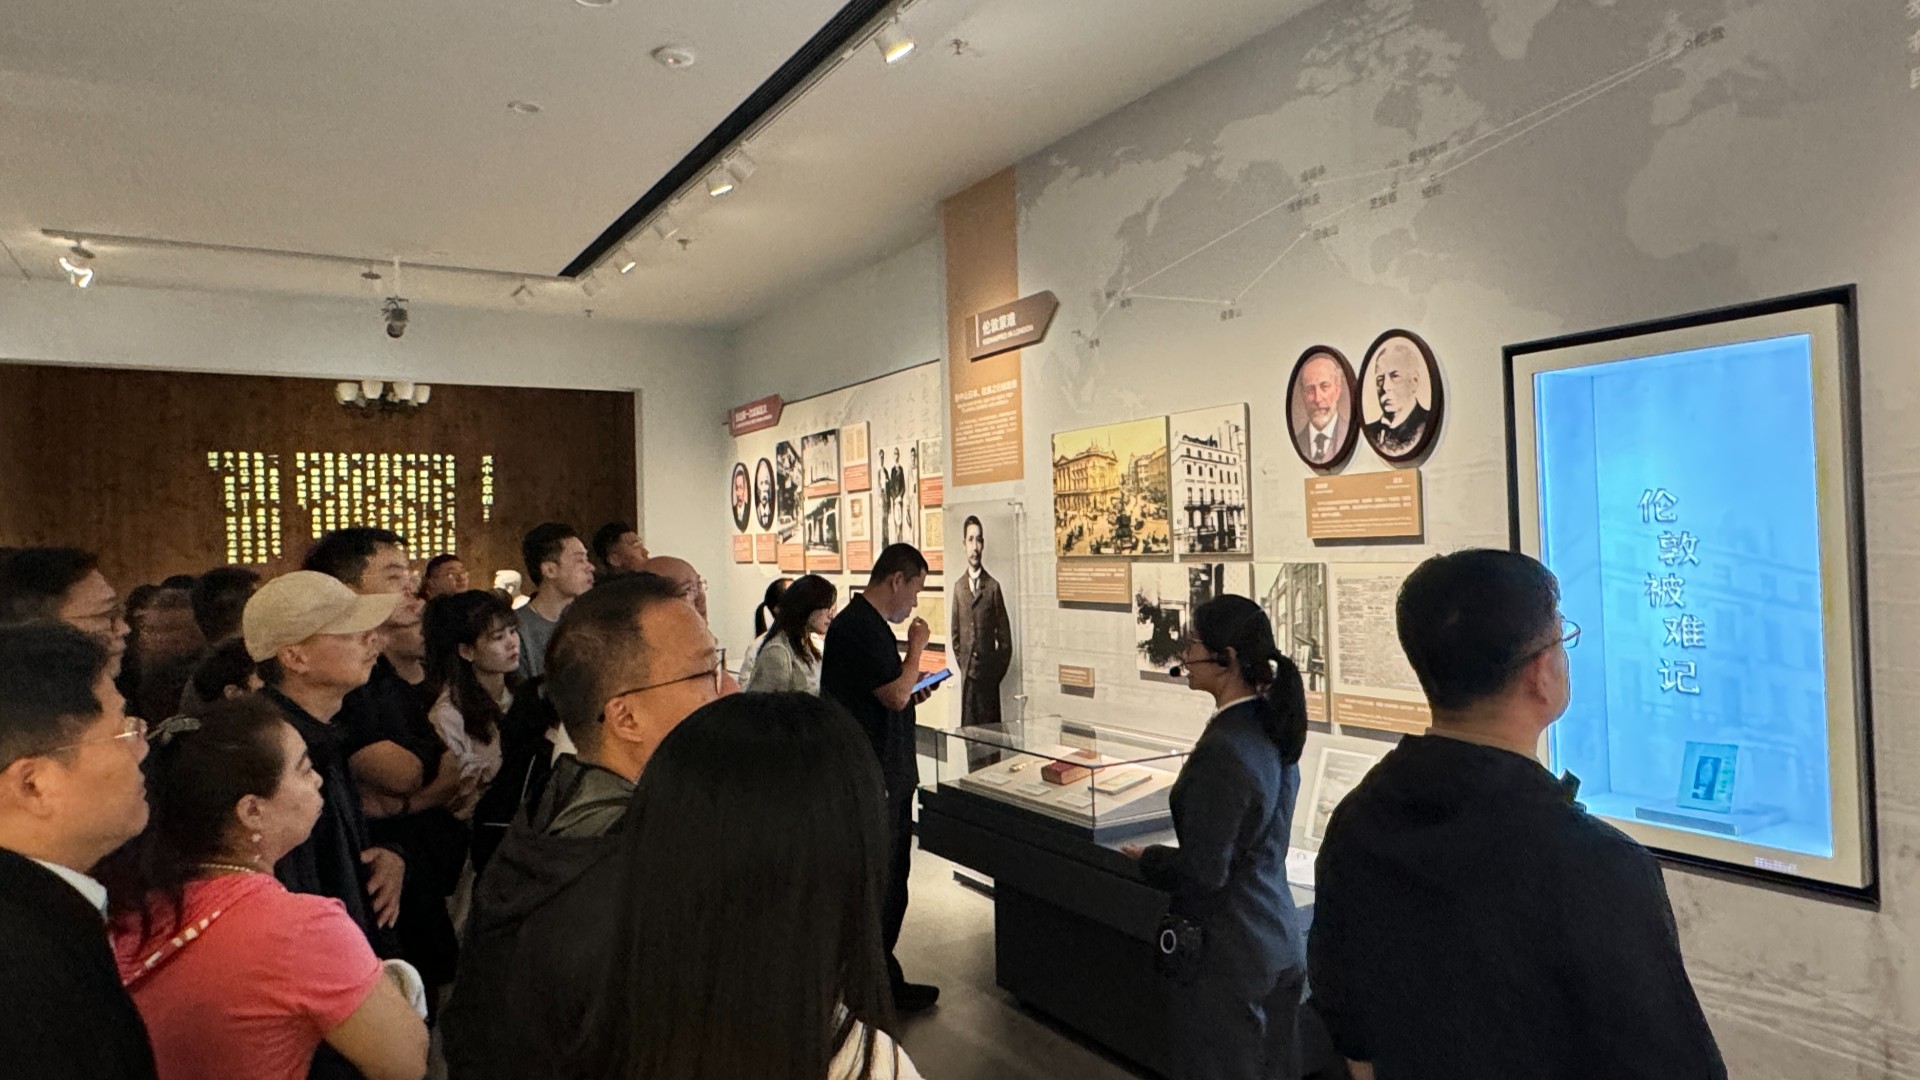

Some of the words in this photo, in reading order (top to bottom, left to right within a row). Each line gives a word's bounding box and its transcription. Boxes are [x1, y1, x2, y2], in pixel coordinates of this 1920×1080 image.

[1637, 487, 1707, 696] 伦敦被难记
